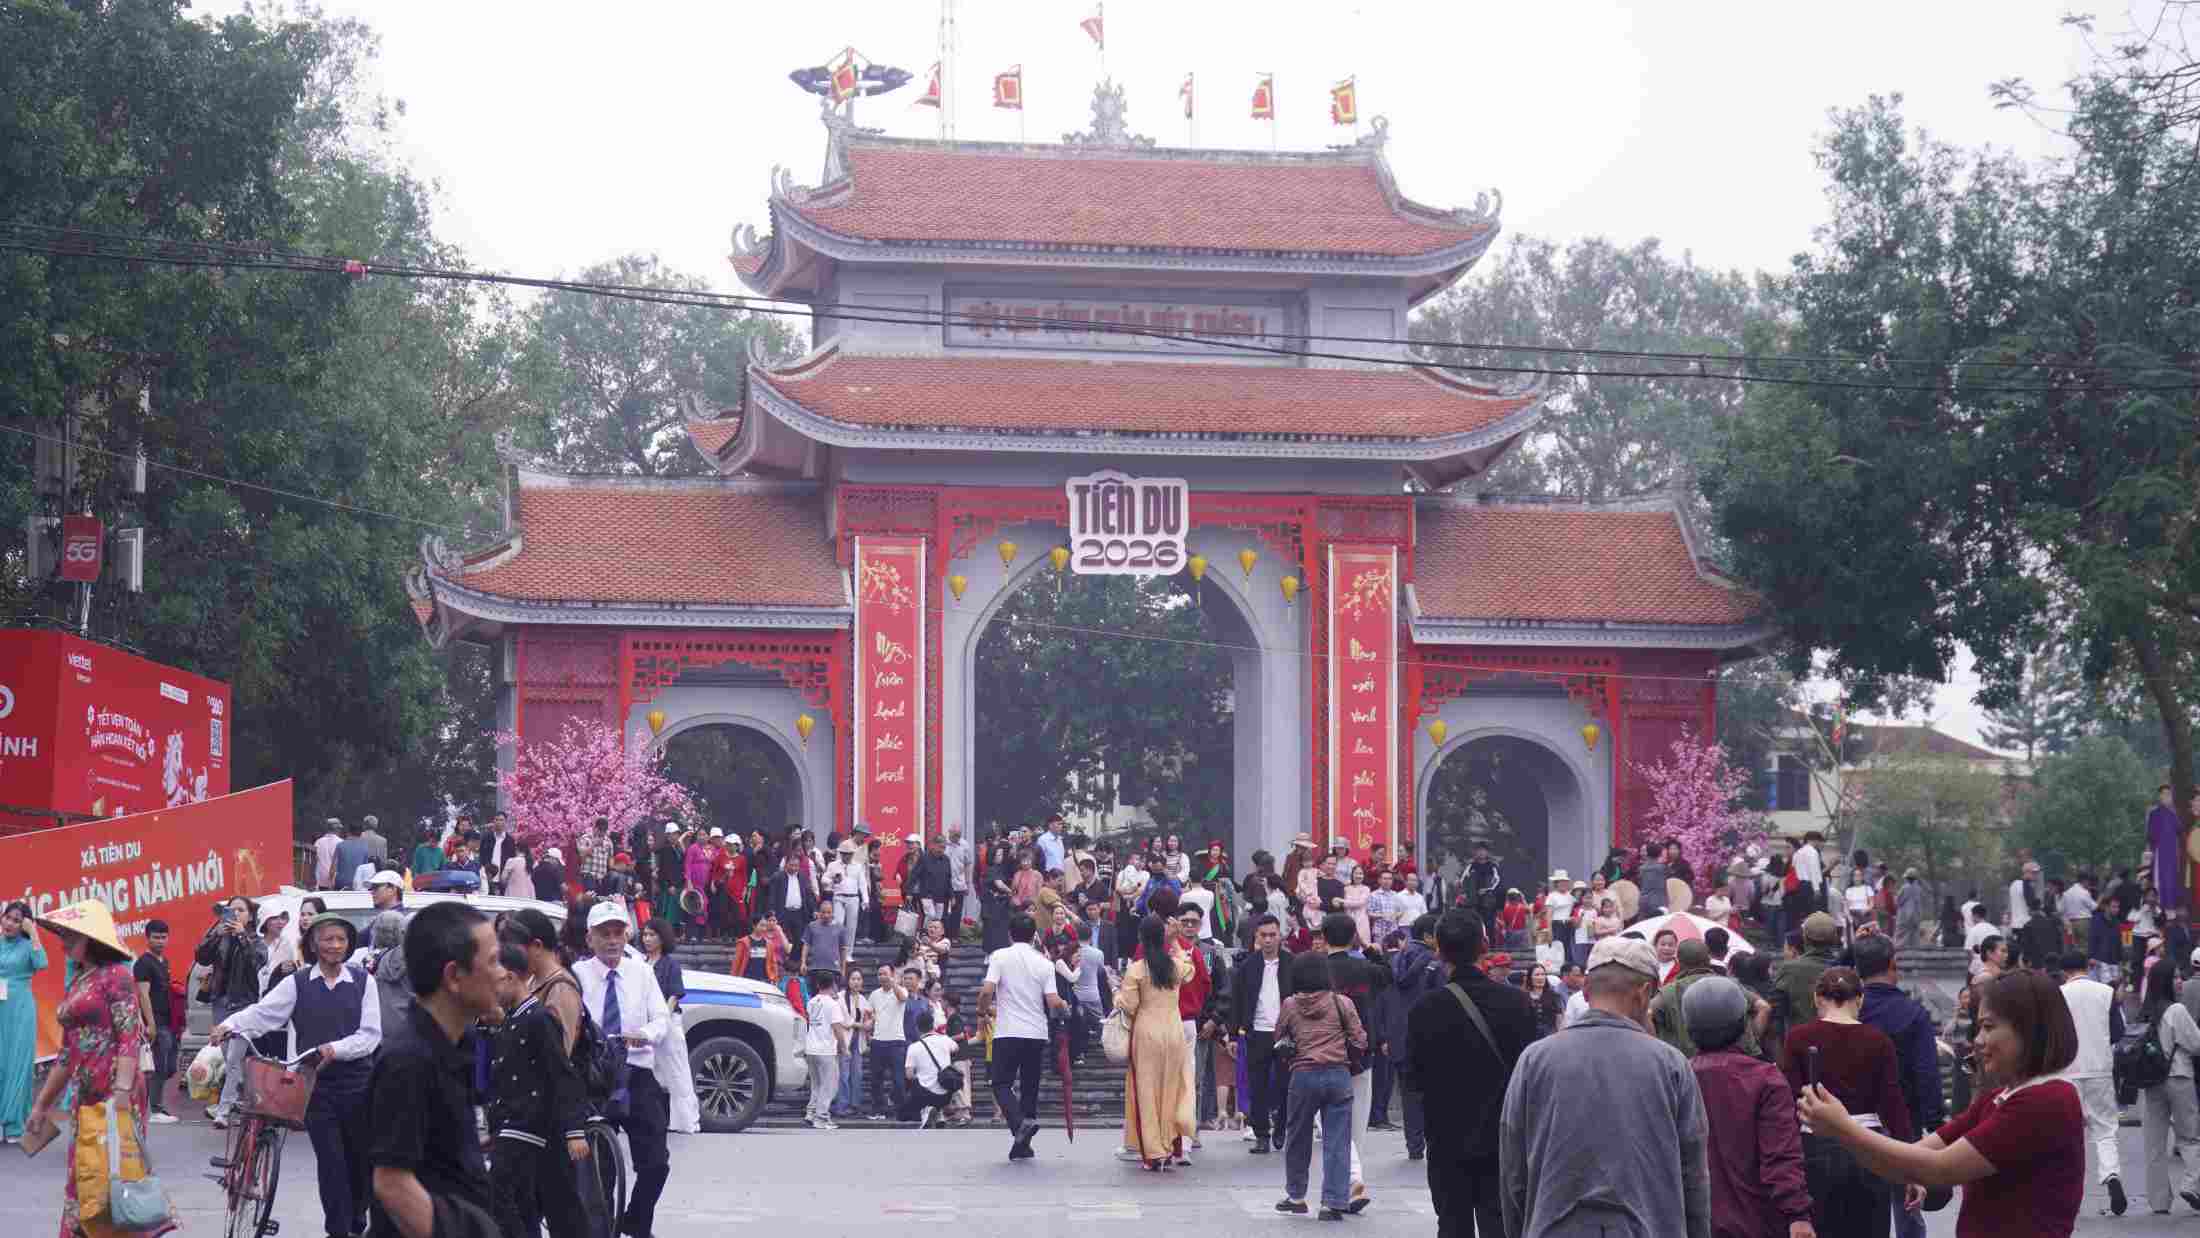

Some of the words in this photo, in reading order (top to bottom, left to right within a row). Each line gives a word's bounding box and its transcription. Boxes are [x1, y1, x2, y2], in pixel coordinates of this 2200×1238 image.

[1141, 485, 1181, 535] DU
[67, 543, 97, 562] 5G
[1080, 538, 1179, 567] 2026
[67, 652, 92, 671] Viettel
[81, 845, 97, 869] XÃ
[125, 839, 142, 861] DU
[133, 861, 184, 908] NĂM
[186, 847, 225, 896] MỚI
